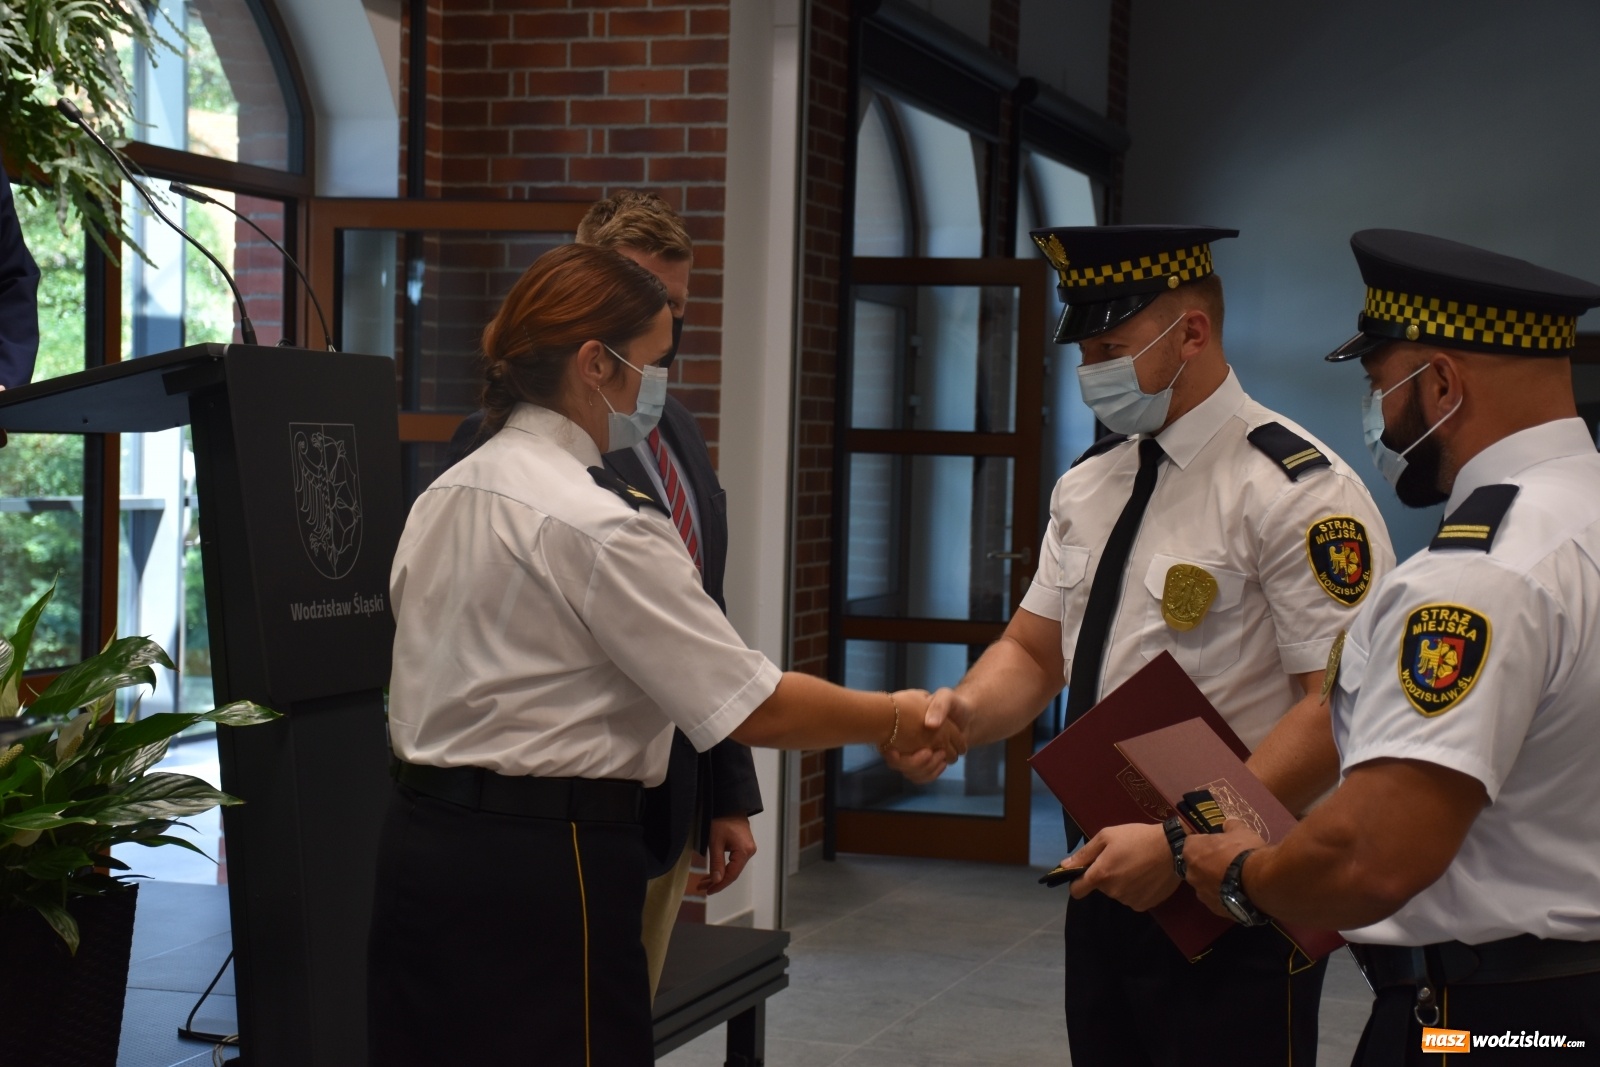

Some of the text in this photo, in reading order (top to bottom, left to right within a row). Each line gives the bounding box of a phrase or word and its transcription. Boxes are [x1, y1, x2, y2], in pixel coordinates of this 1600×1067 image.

[1315, 530, 1363, 545] MIEJSKA
[1319, 571, 1366, 596] WODZISŁAW
[290, 592, 384, 621] Wodzisław Śląski
[1412, 620, 1477, 641] MIEJSKA
[1402, 668, 1459, 703] WODZISŁAW
